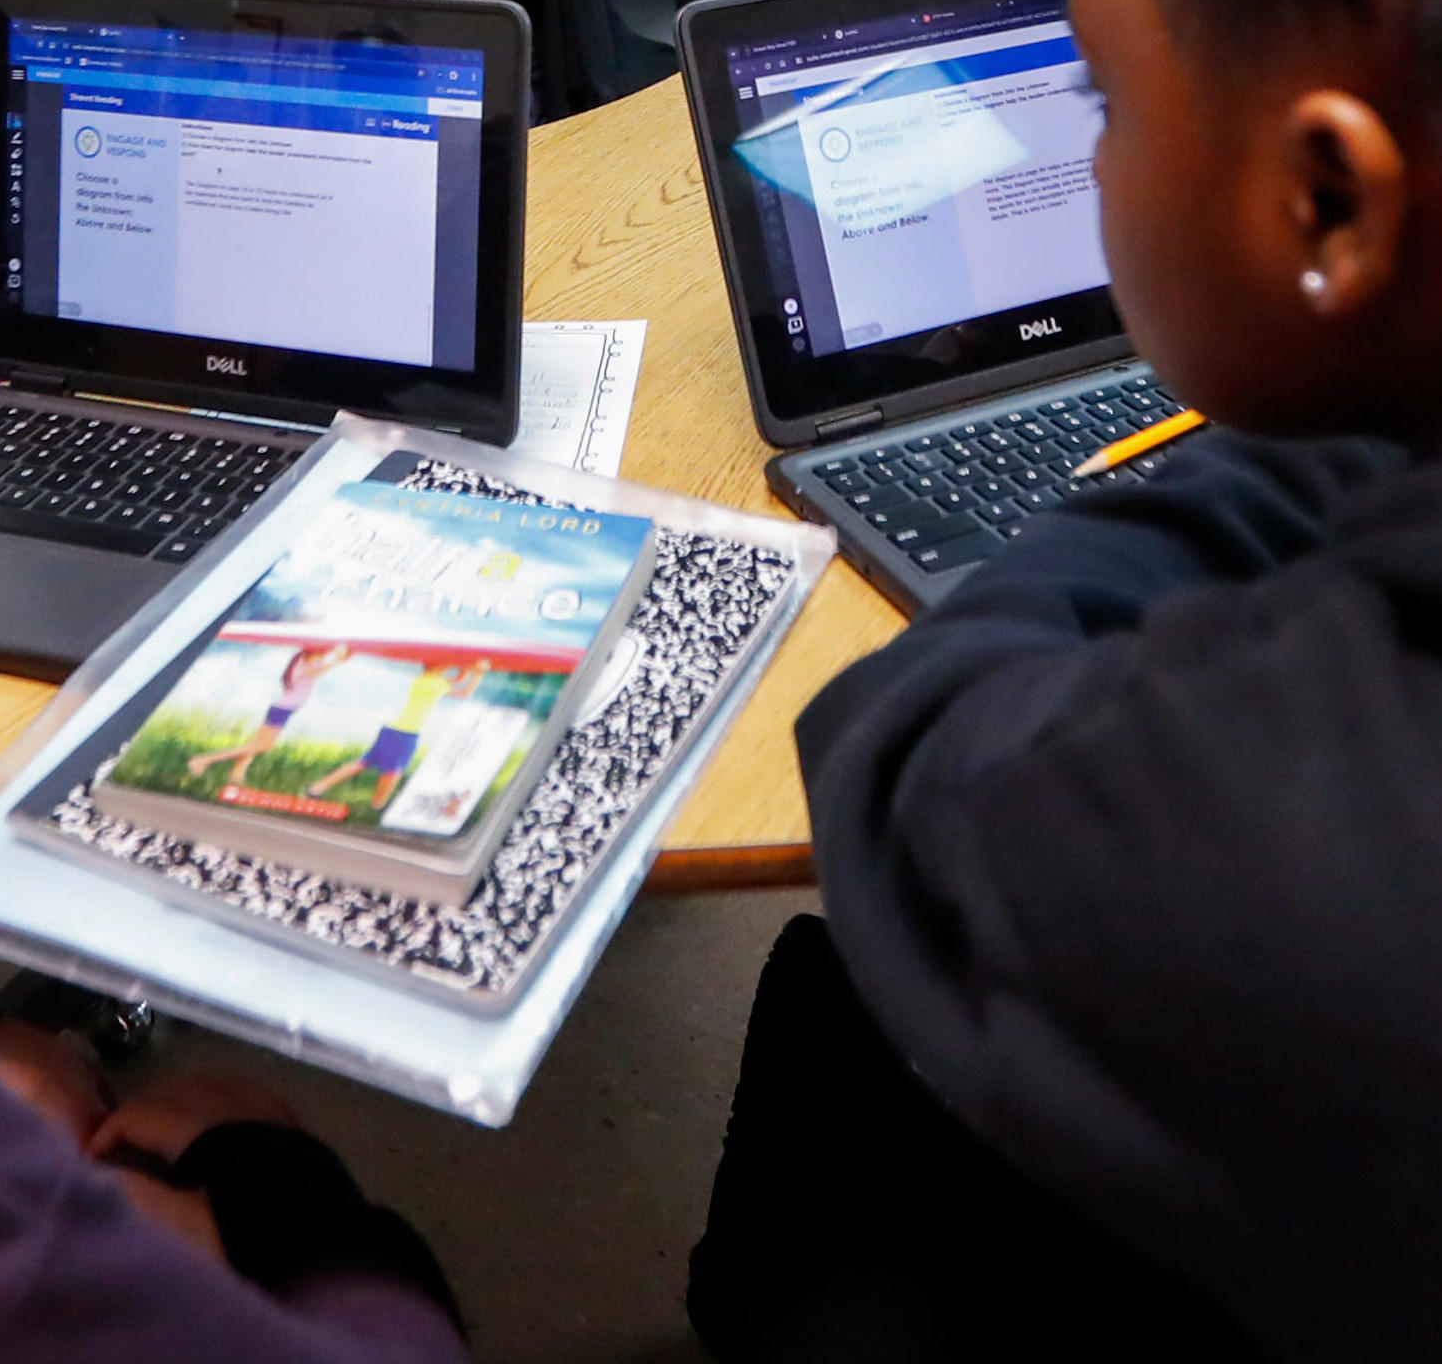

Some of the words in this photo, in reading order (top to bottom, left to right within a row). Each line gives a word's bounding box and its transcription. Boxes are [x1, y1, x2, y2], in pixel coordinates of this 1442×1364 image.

[392, 119, 431, 134] Reading
[842, 226, 875, 241] Above
[877, 220, 898, 233] and
[1019, 316, 1062, 339] DELL
[206, 356, 247, 376] DELL
[520, 513, 602, 536] LORD
[479, 550, 522, 582] a
